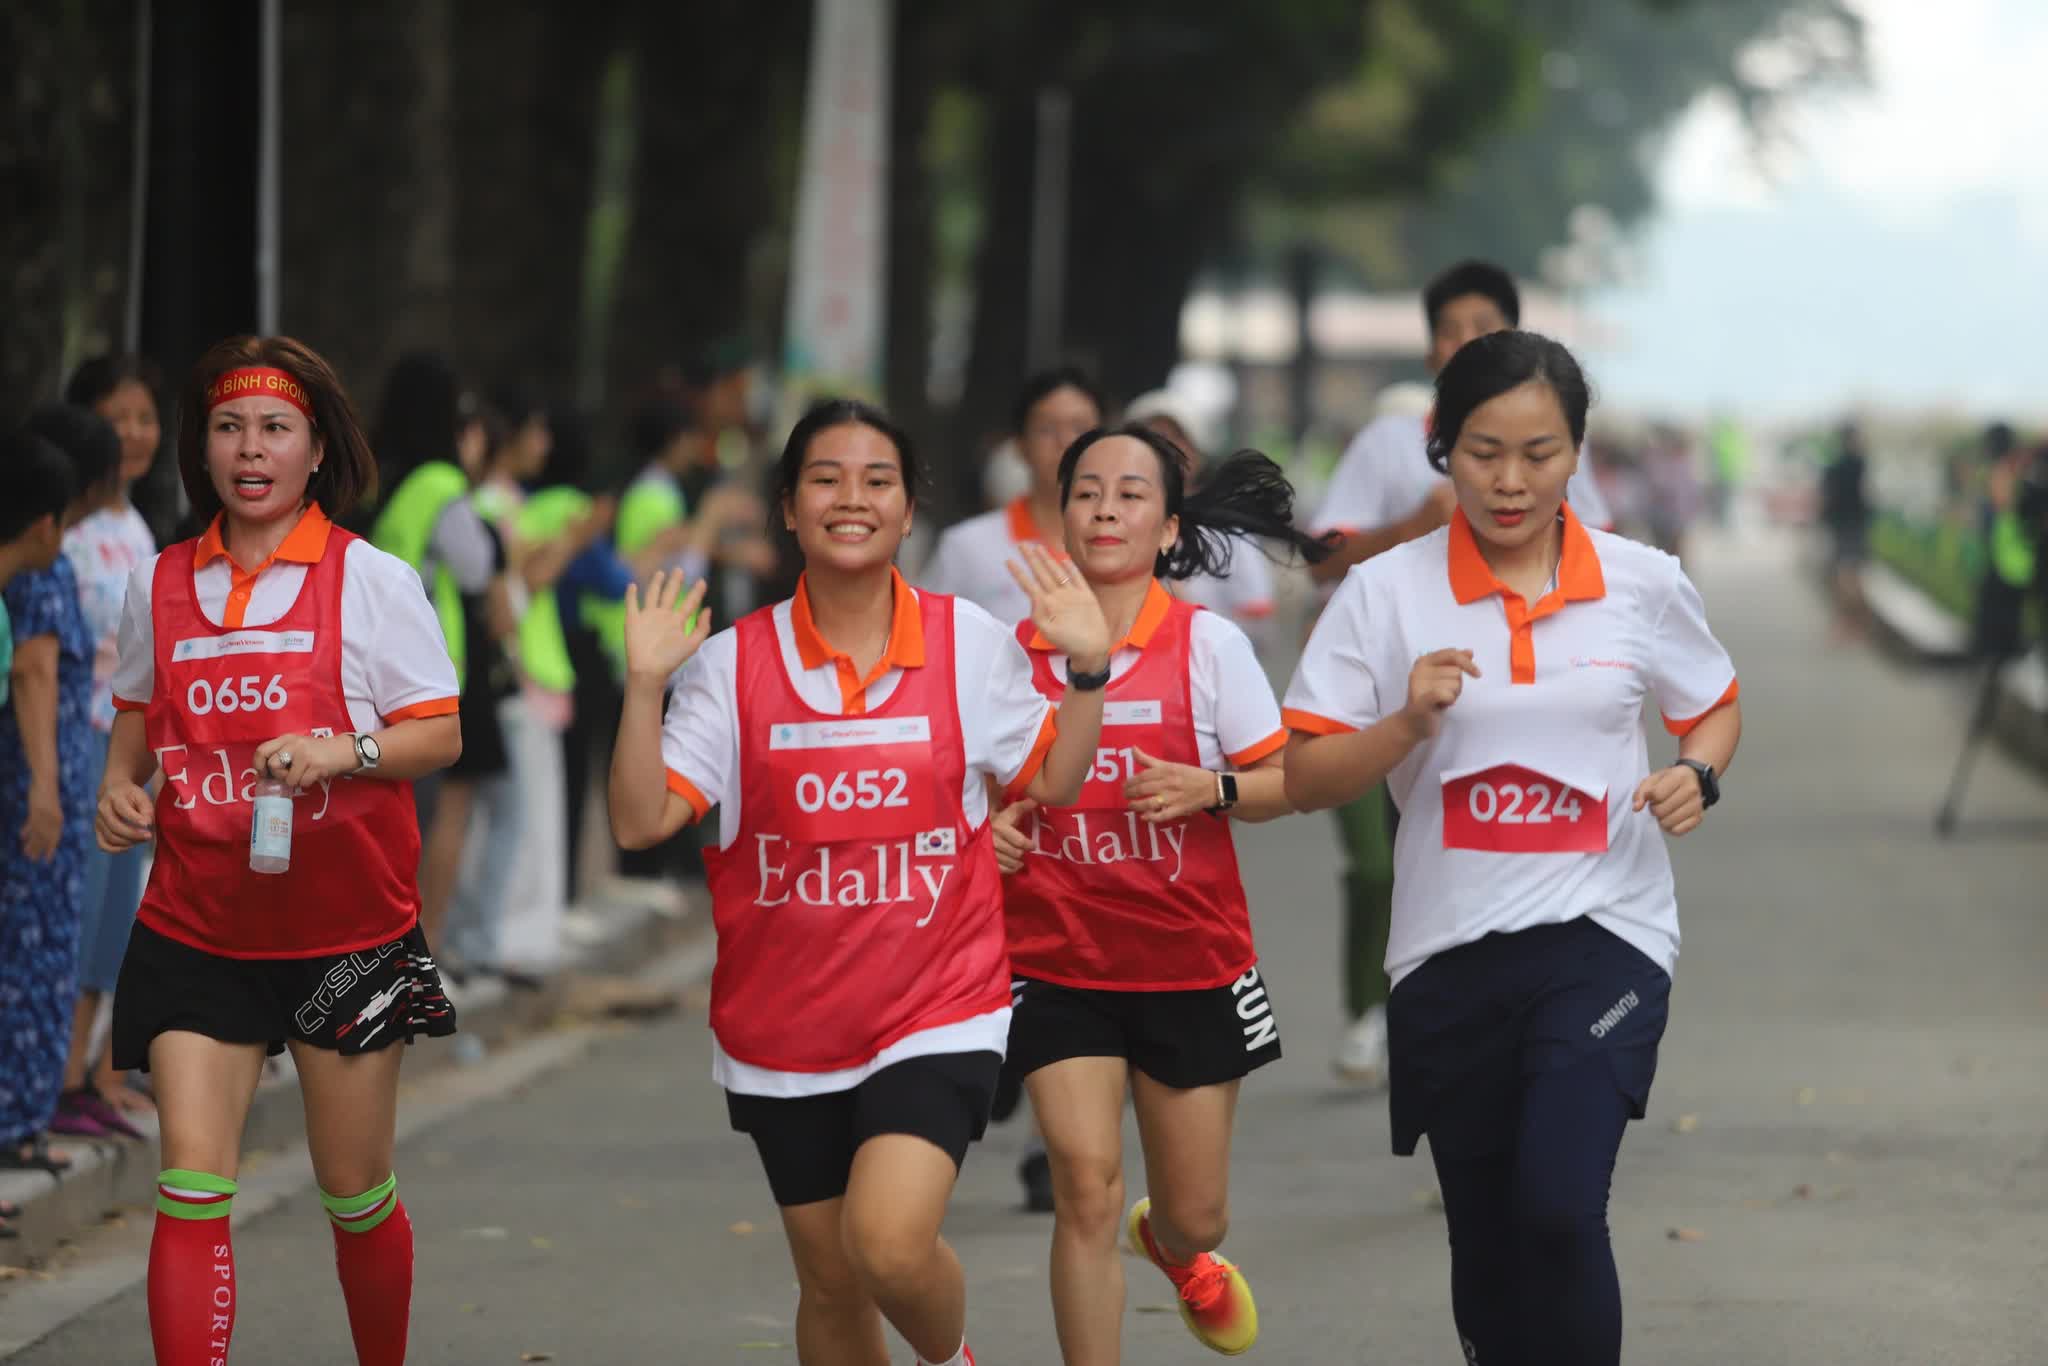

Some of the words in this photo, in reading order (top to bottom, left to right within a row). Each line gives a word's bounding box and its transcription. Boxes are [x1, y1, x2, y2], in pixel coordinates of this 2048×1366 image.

[188, 674, 287, 715] 0656
[795, 768, 909, 814] 0652
[1468, 782, 1583, 824] 0224
[753, 832, 954, 928] Edally
[1030, 806, 1187, 882] Edally
[1231, 966, 1278, 1052] RUN
[210, 1243, 231, 1366] SPORTS
